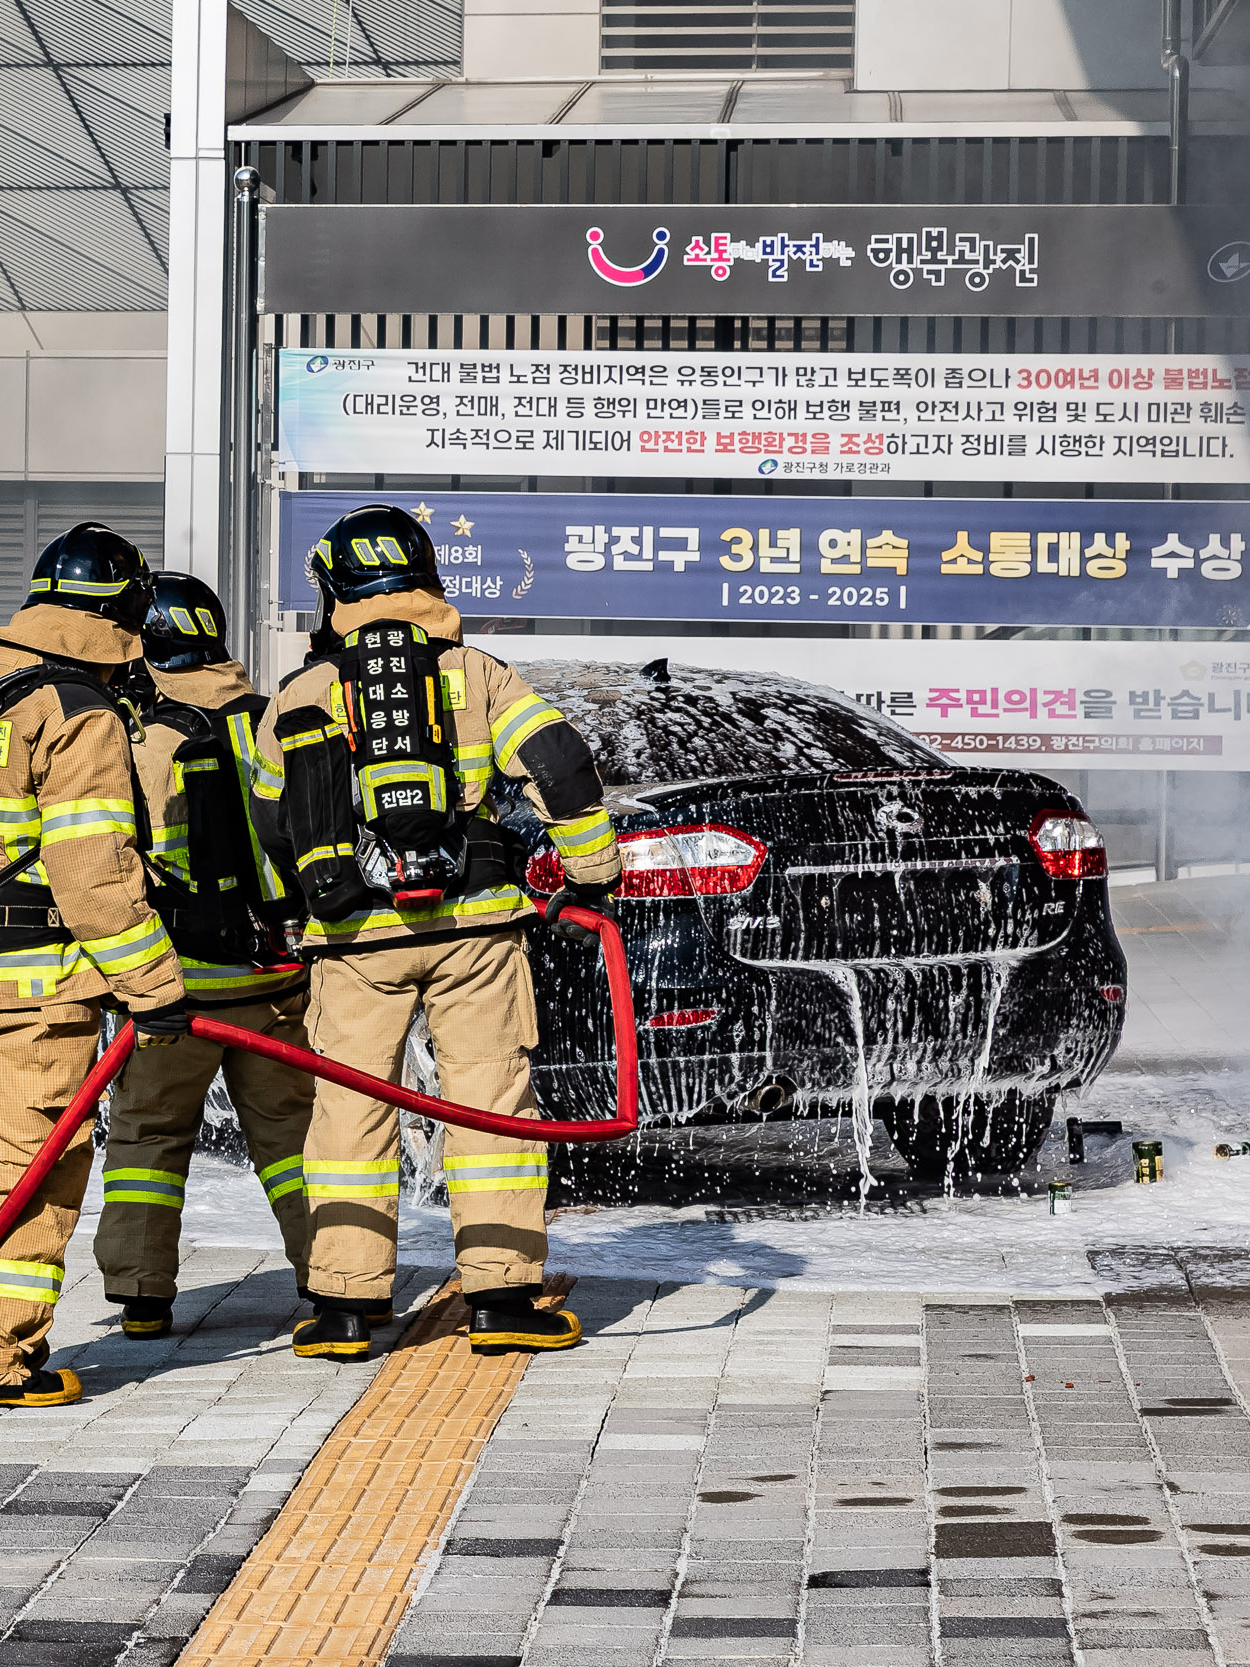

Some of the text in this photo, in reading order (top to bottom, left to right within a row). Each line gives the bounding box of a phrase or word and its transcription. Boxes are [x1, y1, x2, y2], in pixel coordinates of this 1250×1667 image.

[867, 227, 1040, 291] 행복광진
[332, 359, 376, 371] 광진구
[406, 361, 451, 384] 건대
[458, 362, 501, 385] 불법
[508, 363, 551, 385] 노점
[558, 363, 669, 387] 정비지역은
[676, 365, 789, 388] 유동인구가
[795, 366, 839, 389] 많고
[846, 367, 936, 389] 보도폭이
[943, 367, 1012, 389] 좁으나
[1016, 367, 1100, 390] 30여년
[1107, 367, 1155, 391] 이상
[342, 393, 1246, 425] (대리운영, 전매, 전대 등 행위 만연)들로 인해 보행 불편, 안전사고 위험 및 도시 미관 훼손
[425, 427, 1235, 459] 지속적으로 제기되어 안전한 보행환경을 조성하고자 정비를 시행한 지역입니다.
[782, 461, 891, 475] 광진구청 가로경관과
[434, 544, 482, 566] 제8회
[563, 524, 1246, 582] 광진구 3년 연속 소통대상 수상
[737, 584, 802, 606] 2023
[826, 586, 891, 608] 2025
[387, 631, 411, 753] 광진소방서
[925, 687, 1117, 720] 주민의견을
[1128, 688, 1250, 721] 받습니
[381, 789, 423, 809] 진압2
[1042, 900, 1066, 915] RE
